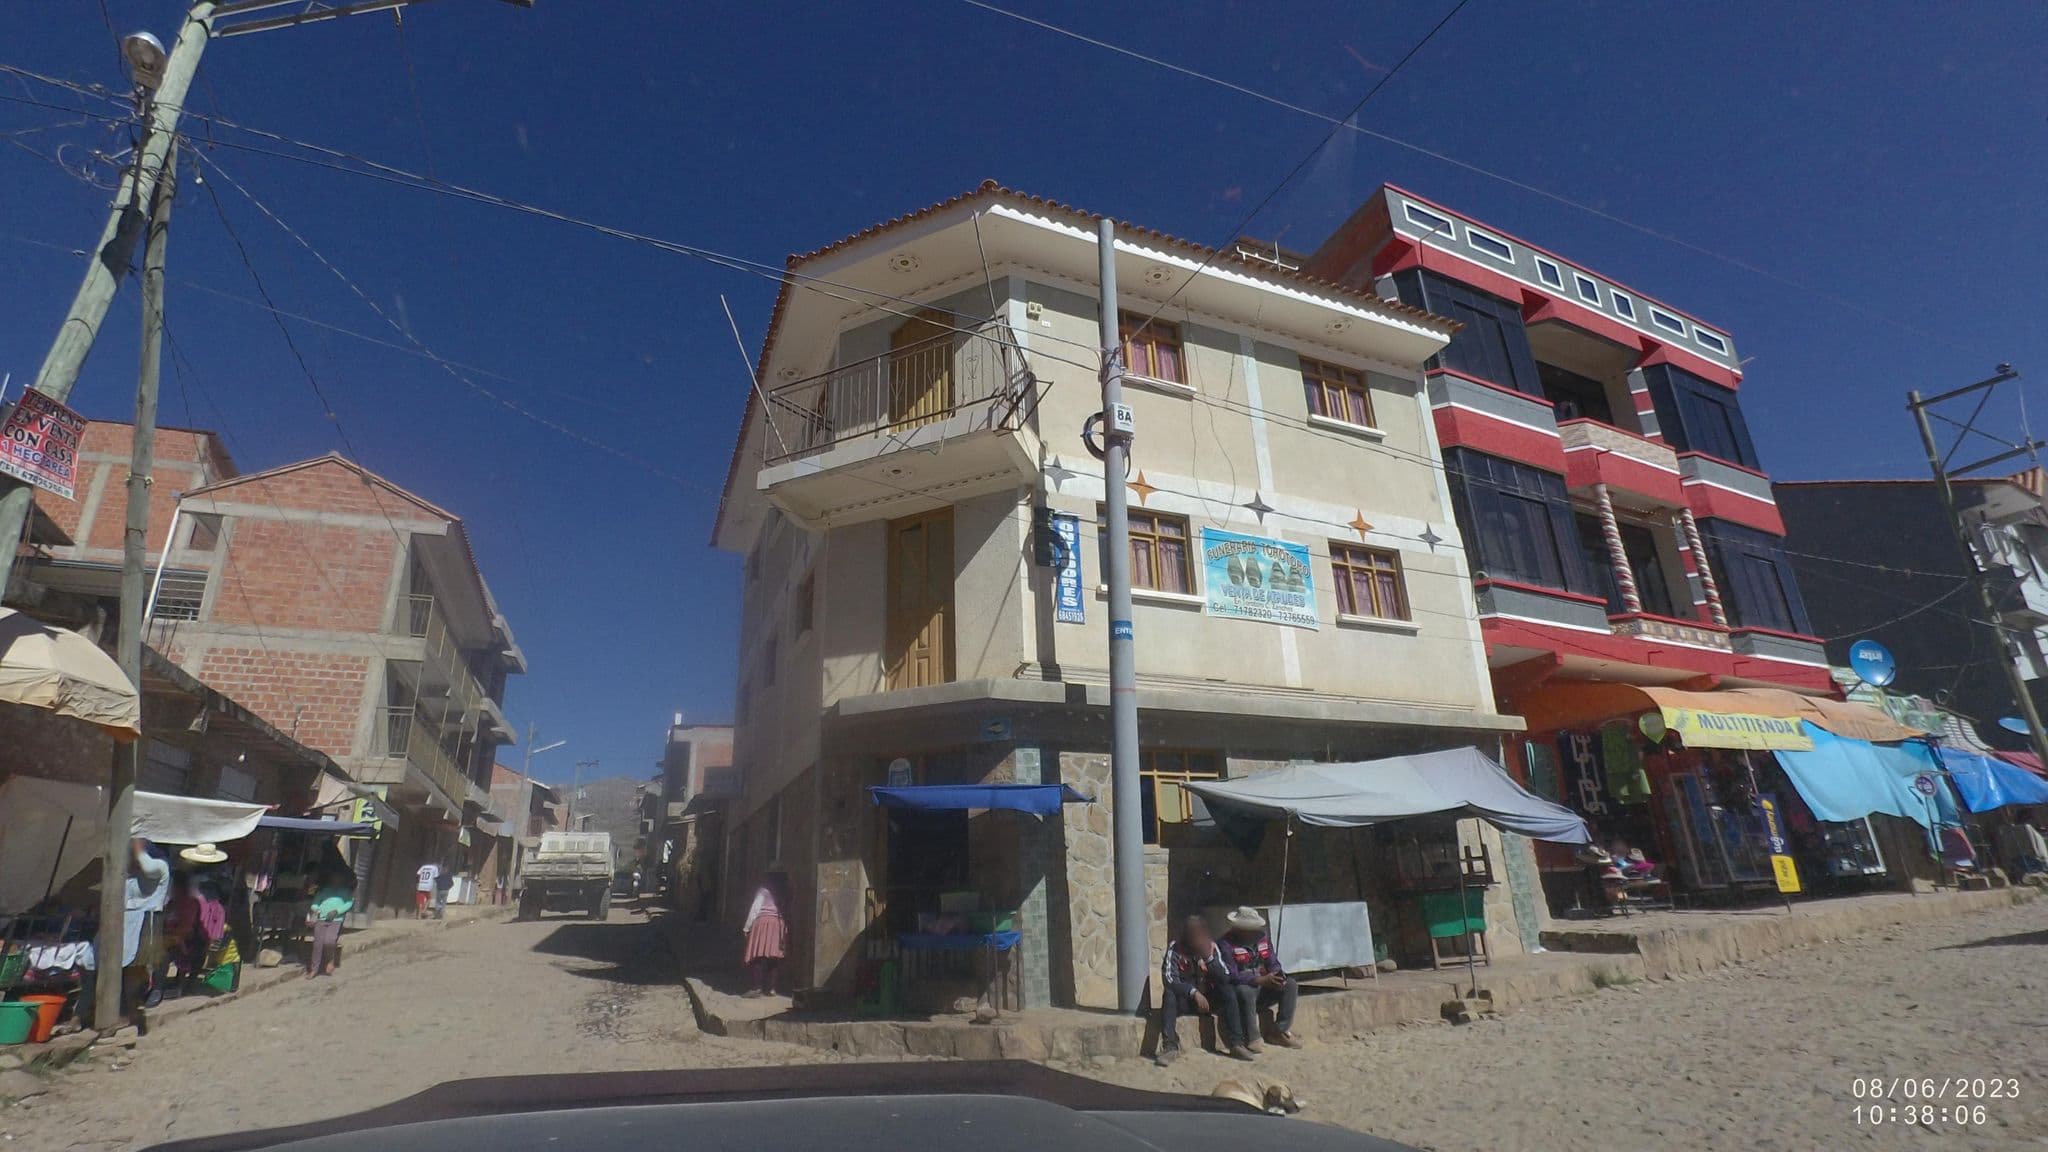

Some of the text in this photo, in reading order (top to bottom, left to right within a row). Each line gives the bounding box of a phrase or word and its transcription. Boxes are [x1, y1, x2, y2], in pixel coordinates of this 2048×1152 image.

[29, 391, 83, 431] TERRENO
[1117, 410, 1132, 423] 8A
[13, 407, 77, 450] EN VENTA
[4, 425, 73, 467] CON CASA
[13, 444, 71, 477] HECTAREA
[1221, 584, 1251, 600] VENTA
[1252, 587, 1266, 602] DE
[1696, 713, 1794, 735] MULTITIENDA
[421, 871, 430, 880] 10
